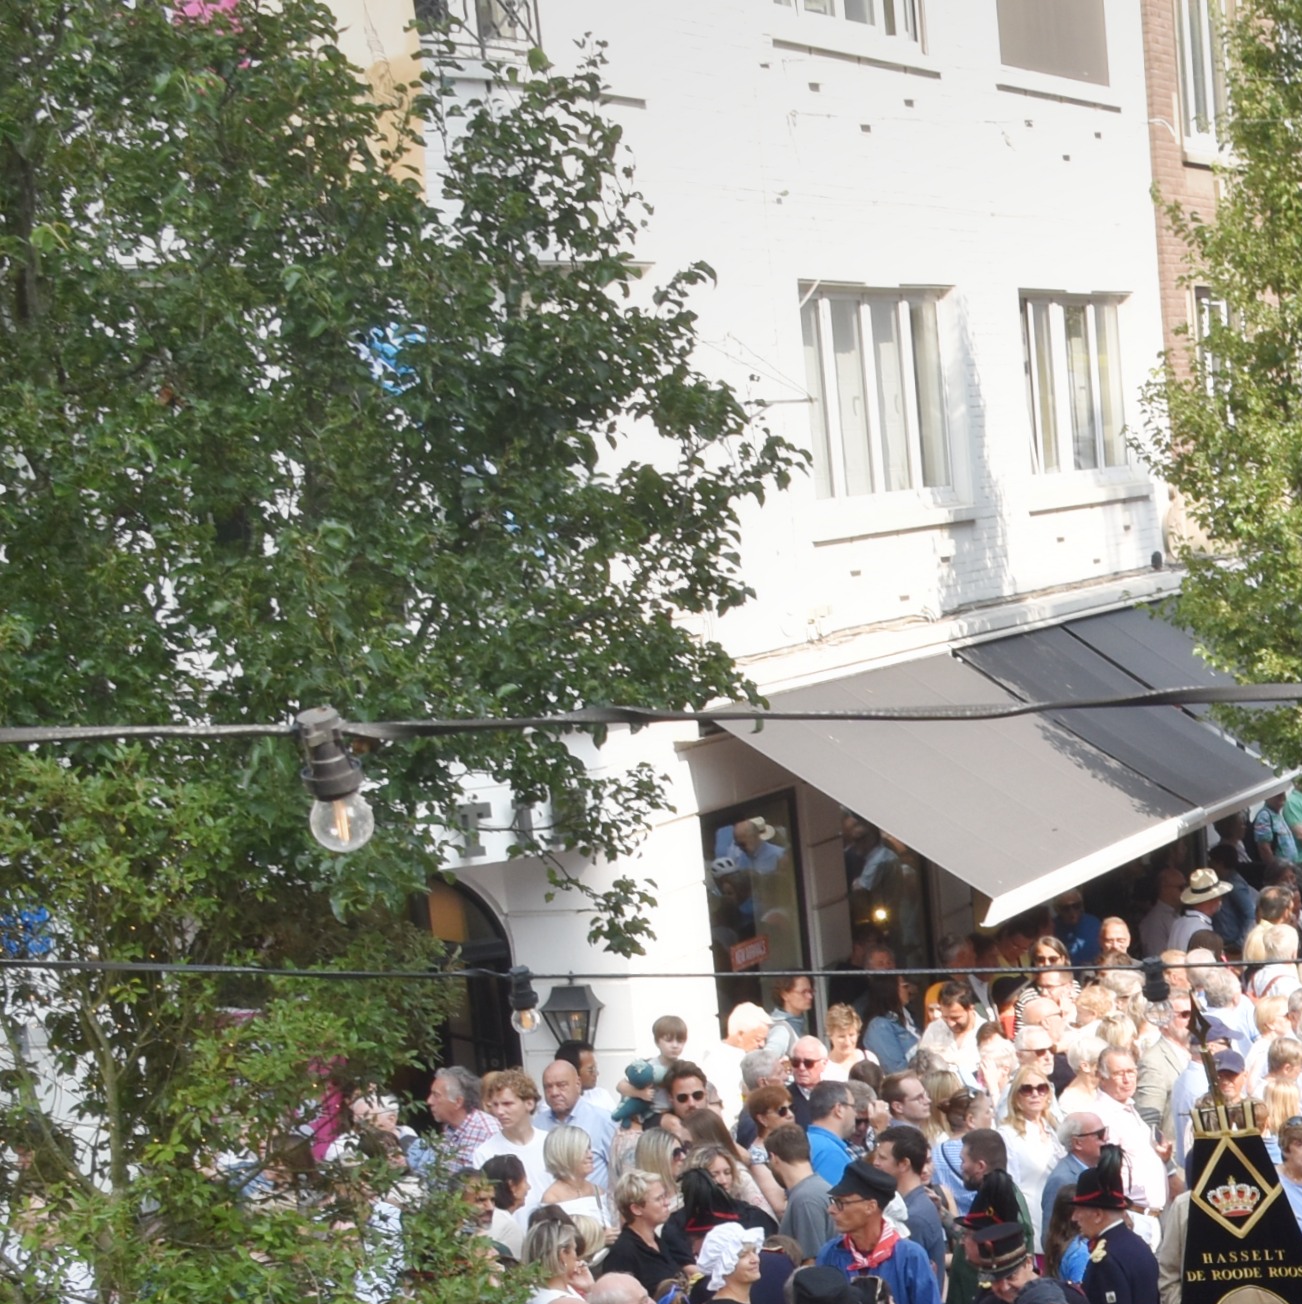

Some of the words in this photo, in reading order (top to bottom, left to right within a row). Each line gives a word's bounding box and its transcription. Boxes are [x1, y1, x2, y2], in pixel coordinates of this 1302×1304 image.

[1202, 1249, 1286, 1264] HASSELT
[1186, 1269, 1206, 1282] DE
[1211, 1267, 1263, 1281] ROODE
